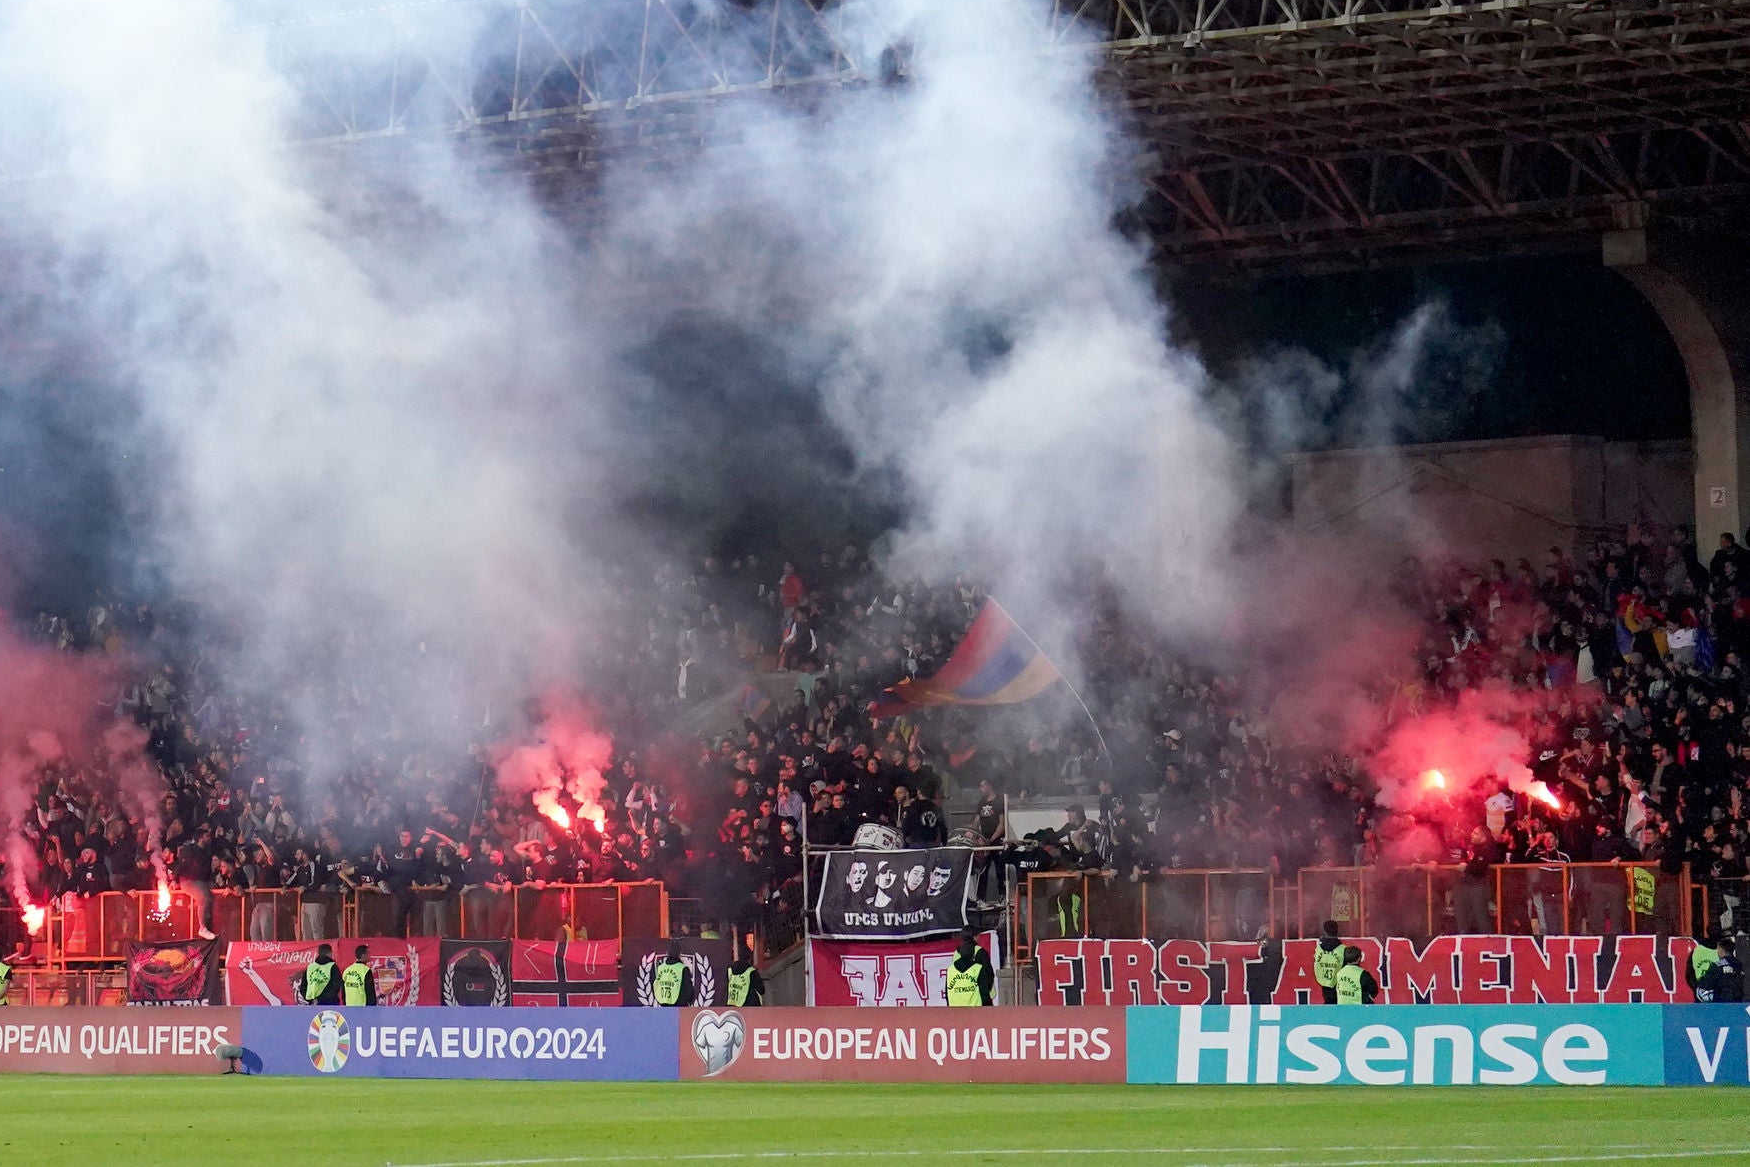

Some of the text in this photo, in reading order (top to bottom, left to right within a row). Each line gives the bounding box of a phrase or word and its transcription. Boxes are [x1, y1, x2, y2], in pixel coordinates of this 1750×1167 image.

[1712, 489, 1724, 504] 2
[1035, 938, 1264, 1005] FIRST
[79, 1025, 231, 1060] QUALIFIERS
[753, 1027, 1111, 1066] EUROPEAN QUALIFIERS
[1176, 1004, 1608, 1085] Hisense
